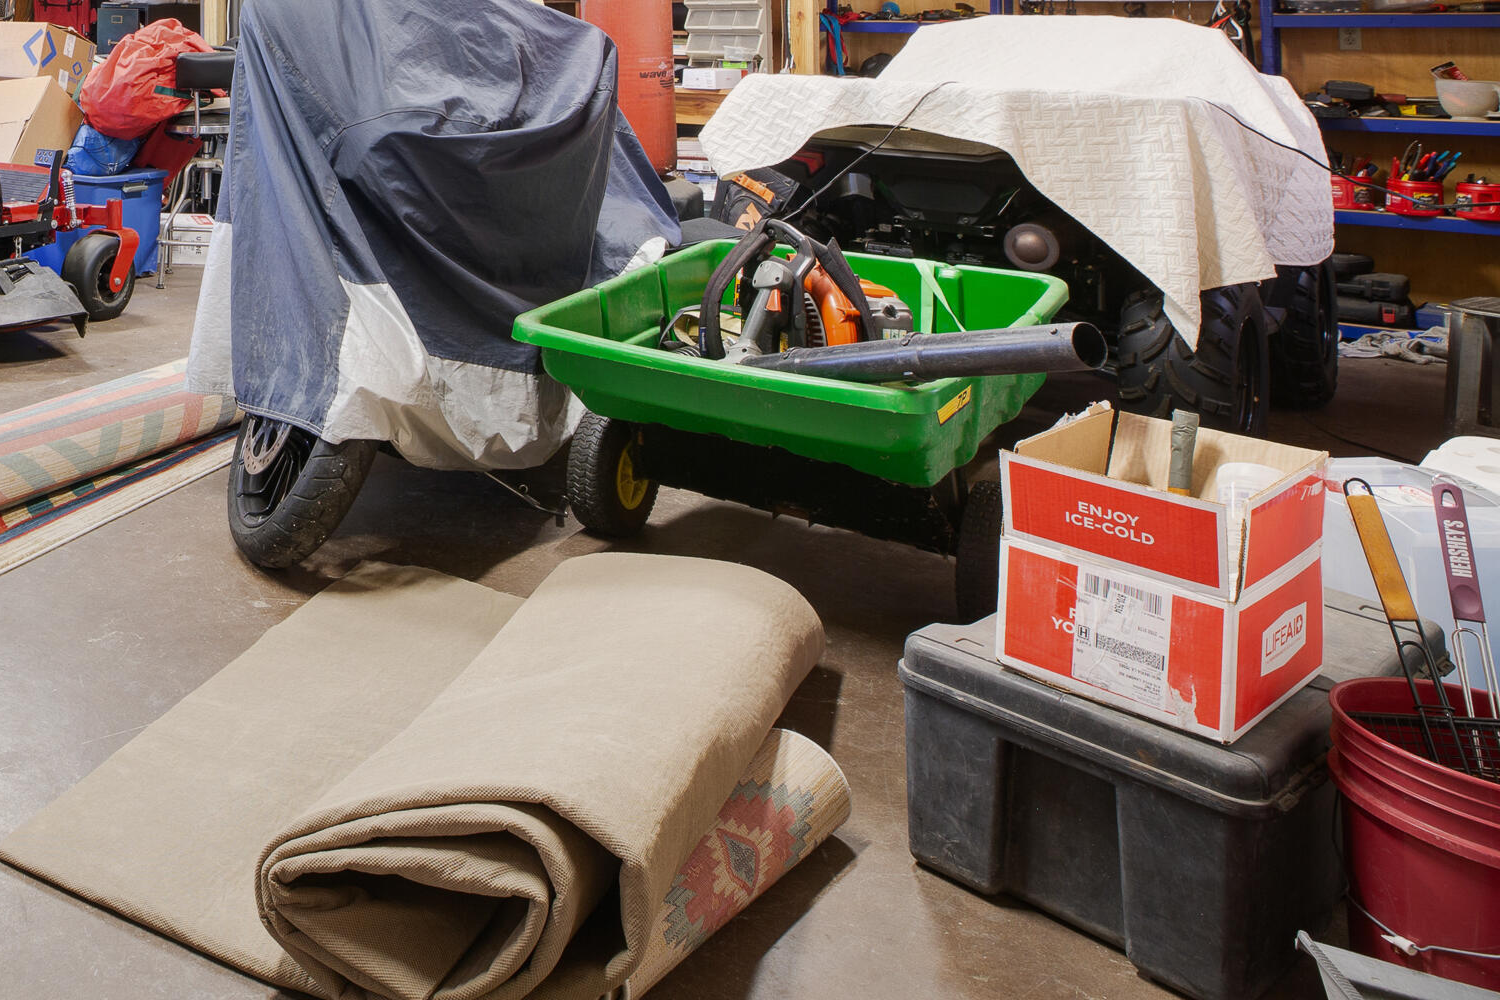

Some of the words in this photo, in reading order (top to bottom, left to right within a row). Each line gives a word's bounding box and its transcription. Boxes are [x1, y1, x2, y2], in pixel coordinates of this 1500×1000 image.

[1065, 511, 1155, 545] ICE-COLD
[1078, 501, 1140, 527] ENJOY
[1443, 519, 1474, 579] HERSHEY'S
[1265, 614, 1303, 657] LIFEAID
